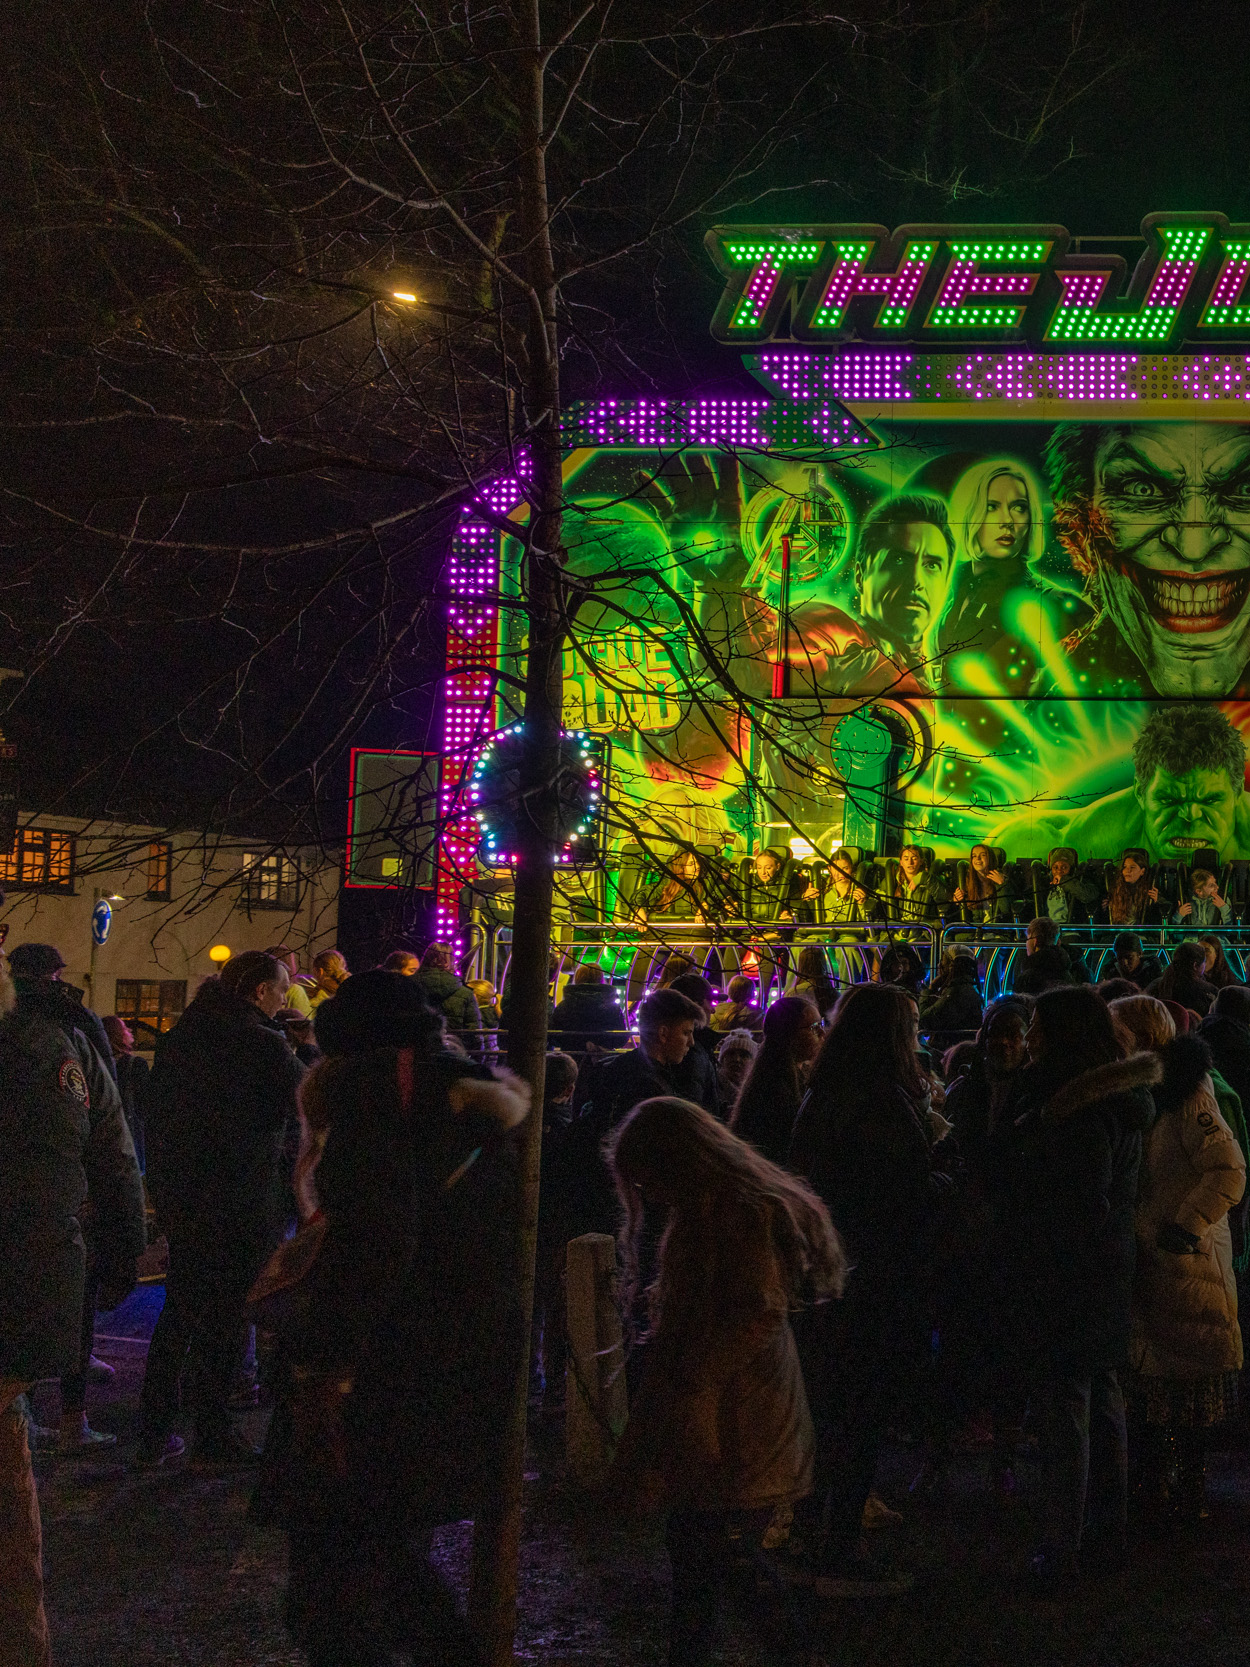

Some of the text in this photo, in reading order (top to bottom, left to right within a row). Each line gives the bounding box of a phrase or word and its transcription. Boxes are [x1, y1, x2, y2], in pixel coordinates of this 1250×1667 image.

[722, 240, 1056, 329] THE
[520, 624, 671, 679] ICIDE
[519, 672, 682, 734] QUAD
